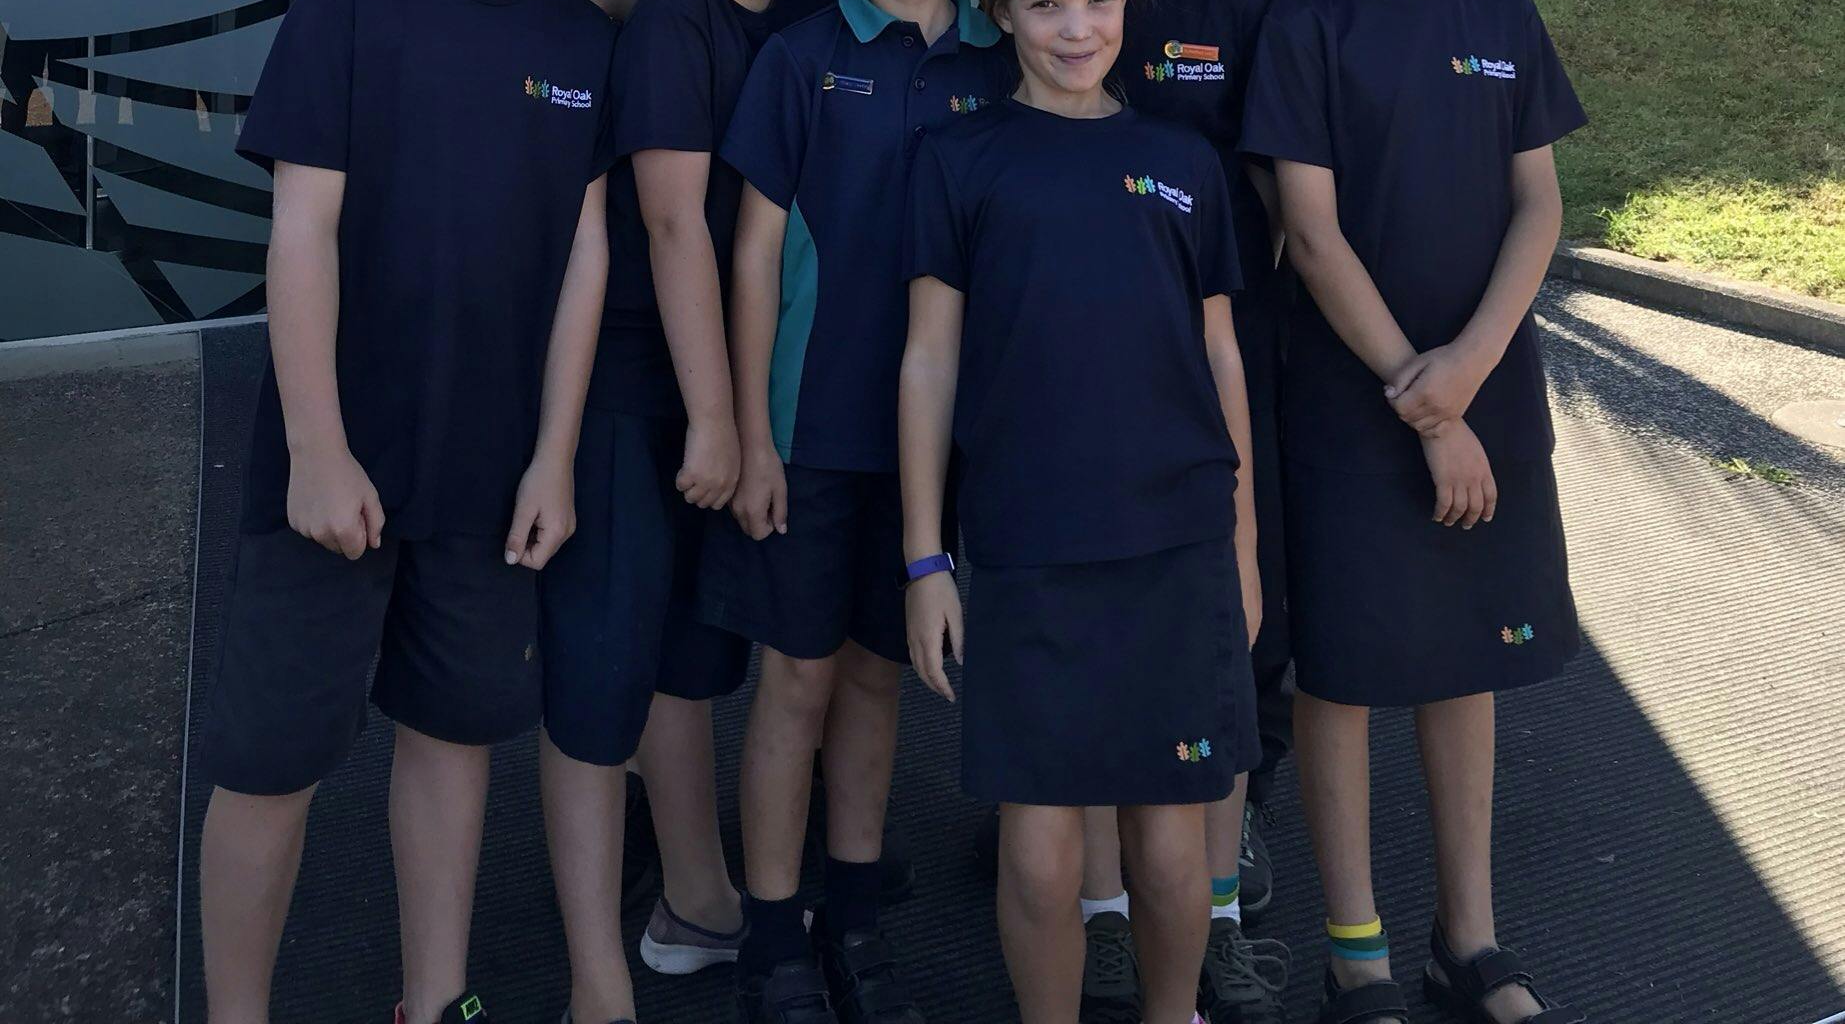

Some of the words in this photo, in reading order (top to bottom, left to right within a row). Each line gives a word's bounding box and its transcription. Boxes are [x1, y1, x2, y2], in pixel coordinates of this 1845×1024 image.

[1177, 63, 1203, 74] Royal
[1204, 62, 1225, 73] Oak
[1203, 73, 1225, 81] School
[572, 89, 592, 101] Oak
[571, 100, 592, 108] School
[1157, 181, 1179, 197] Royal
